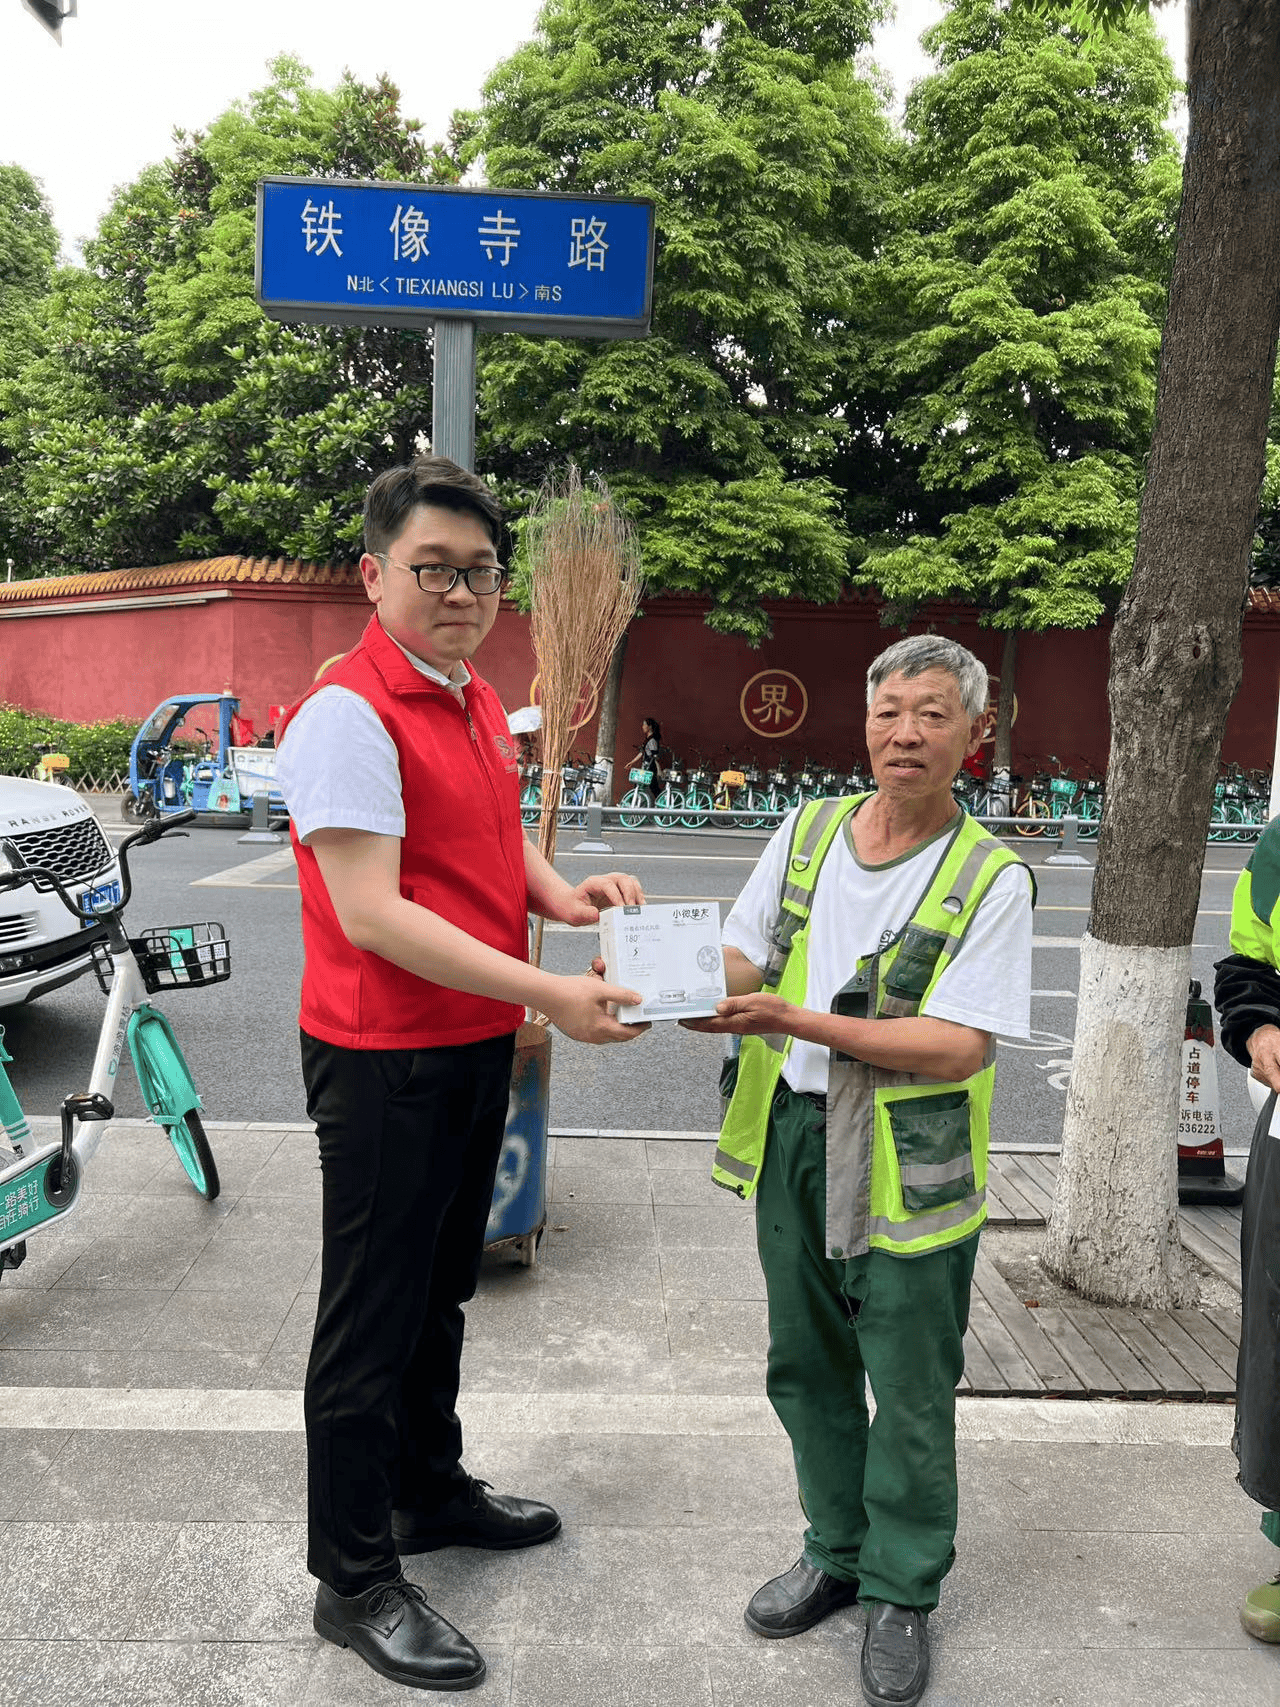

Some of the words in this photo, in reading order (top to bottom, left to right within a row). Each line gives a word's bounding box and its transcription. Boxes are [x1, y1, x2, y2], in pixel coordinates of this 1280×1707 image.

[300, 199, 610, 272] 铁像寺路
[395, 277, 484, 298] TIEXIANGSI
[492, 281, 514, 299] LU
[752, 683, 794, 725] 界
[1185, 1047, 1201, 1104] 占道停车
[1178, 1123, 1216, 1134] 536222
